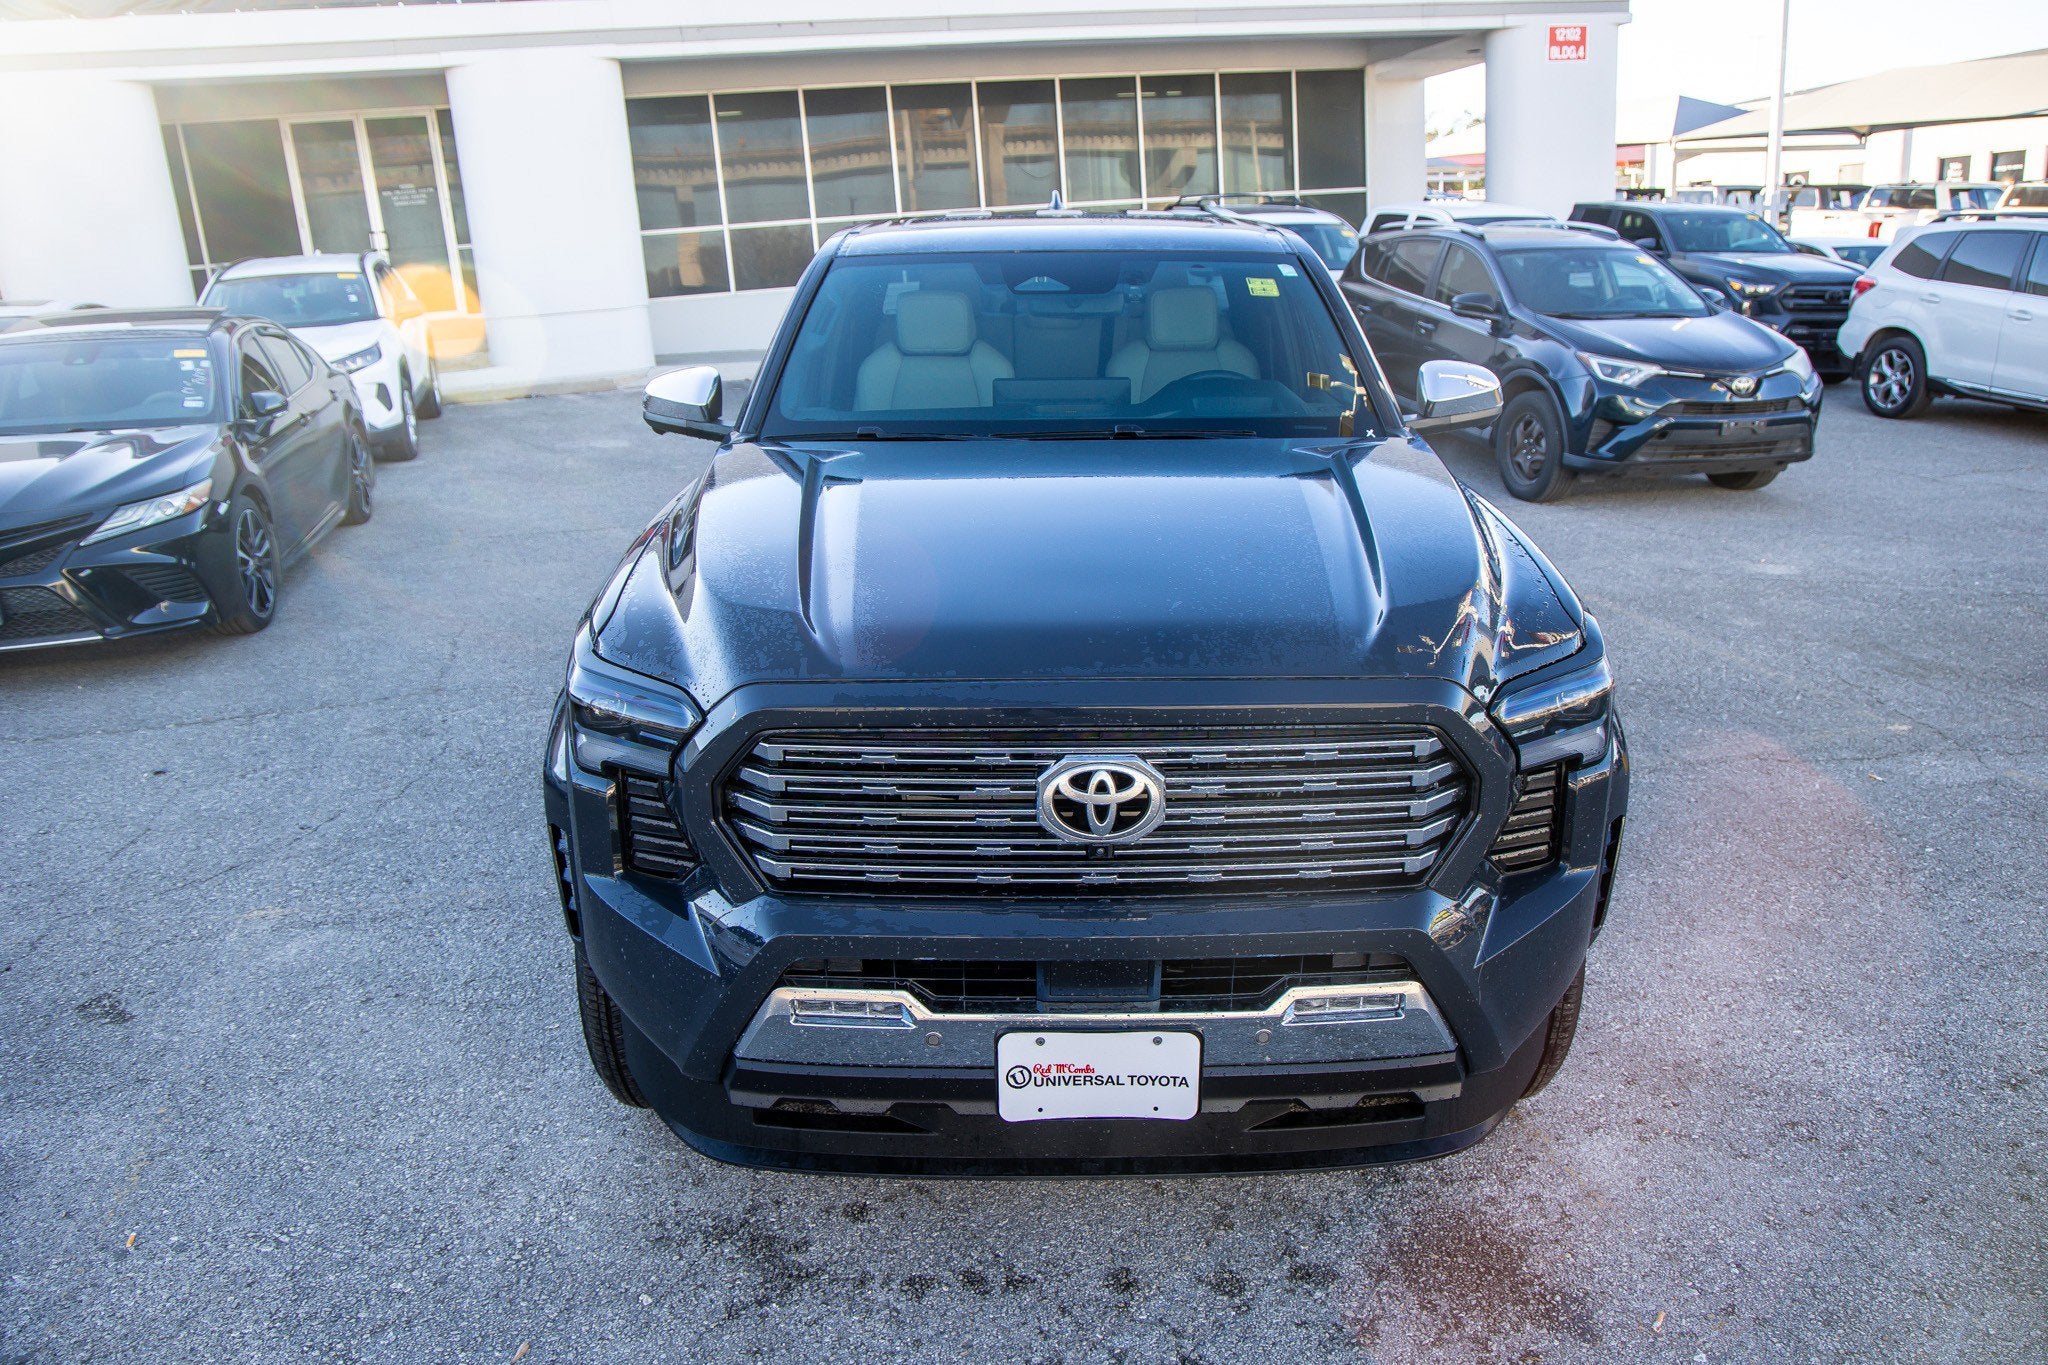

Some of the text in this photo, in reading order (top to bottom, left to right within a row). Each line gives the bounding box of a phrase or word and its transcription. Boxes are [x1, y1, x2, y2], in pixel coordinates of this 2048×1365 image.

[1033, 1064, 1095, 1077] Red McCombs
[1033, 1075, 1189, 1088] UNIVERSAL TOYOTA
